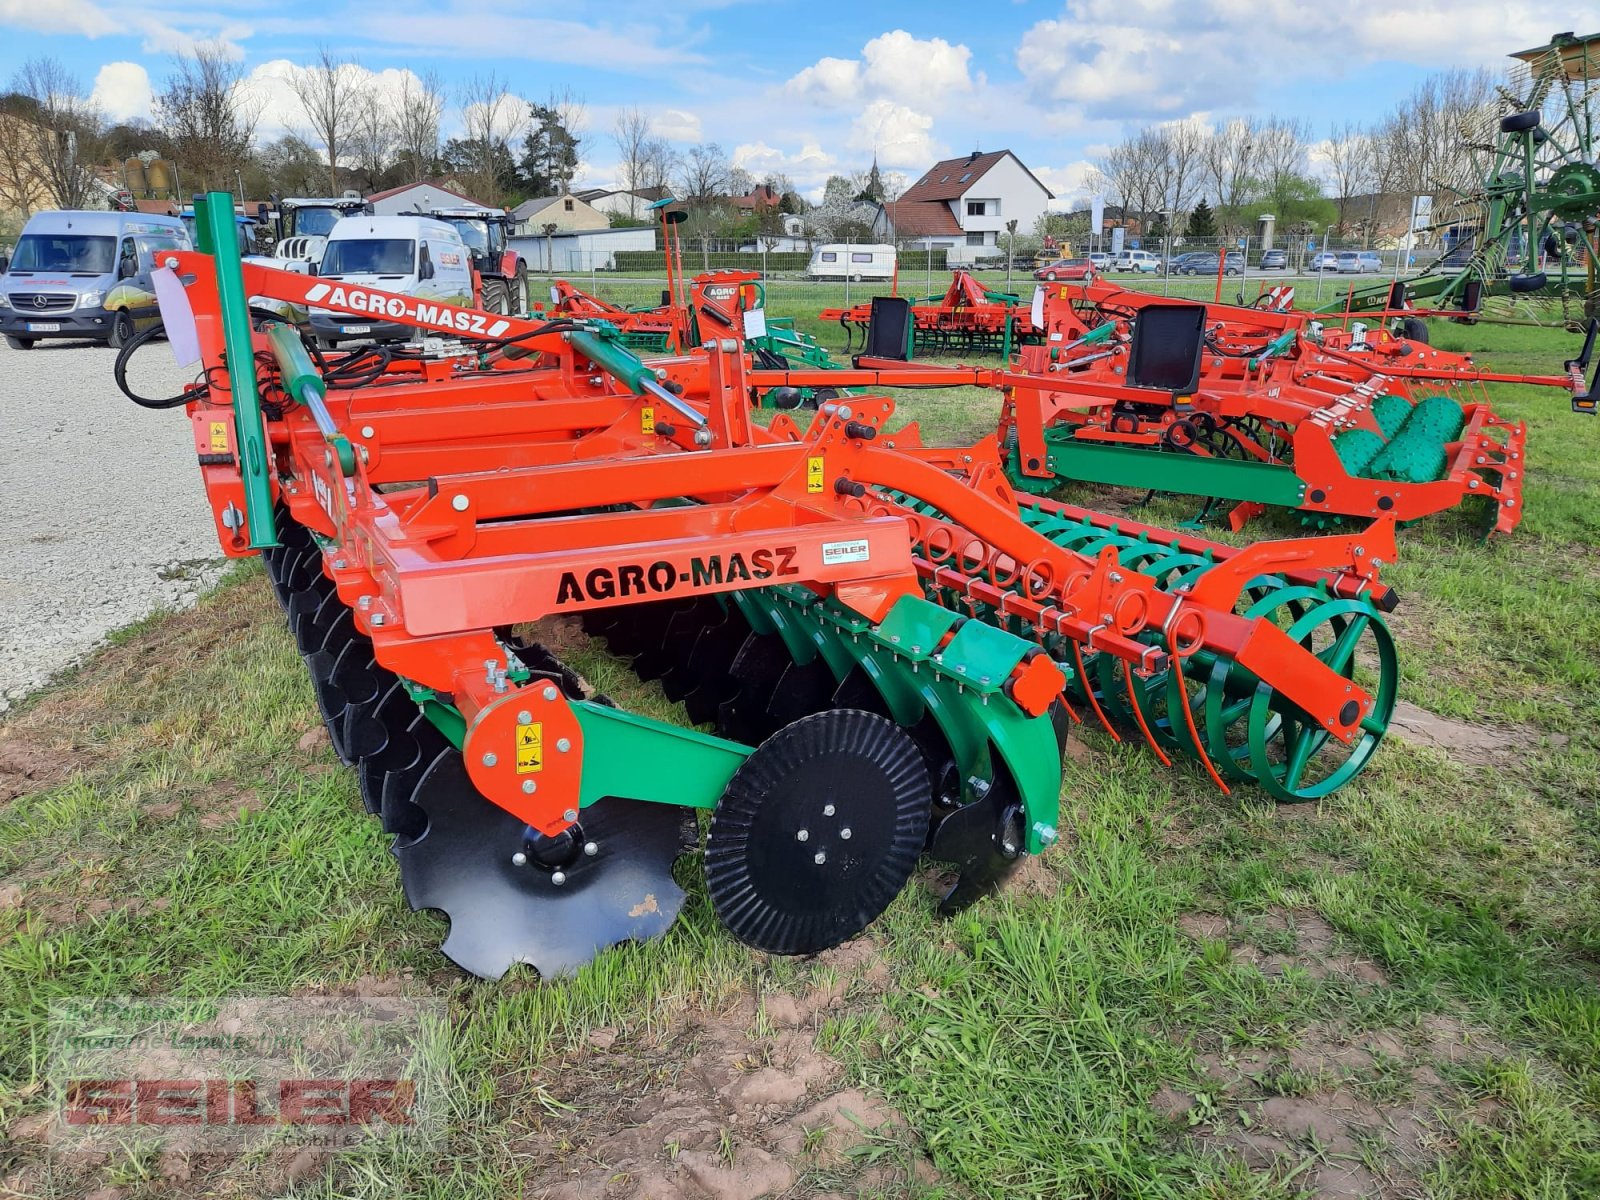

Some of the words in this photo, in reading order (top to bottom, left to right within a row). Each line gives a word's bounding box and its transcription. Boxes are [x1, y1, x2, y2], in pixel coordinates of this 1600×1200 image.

[328, 287, 487, 334] AGRO-MASZ
[825, 546, 866, 555] SEILER
[555, 546, 799, 605] AGRO-MASZ
